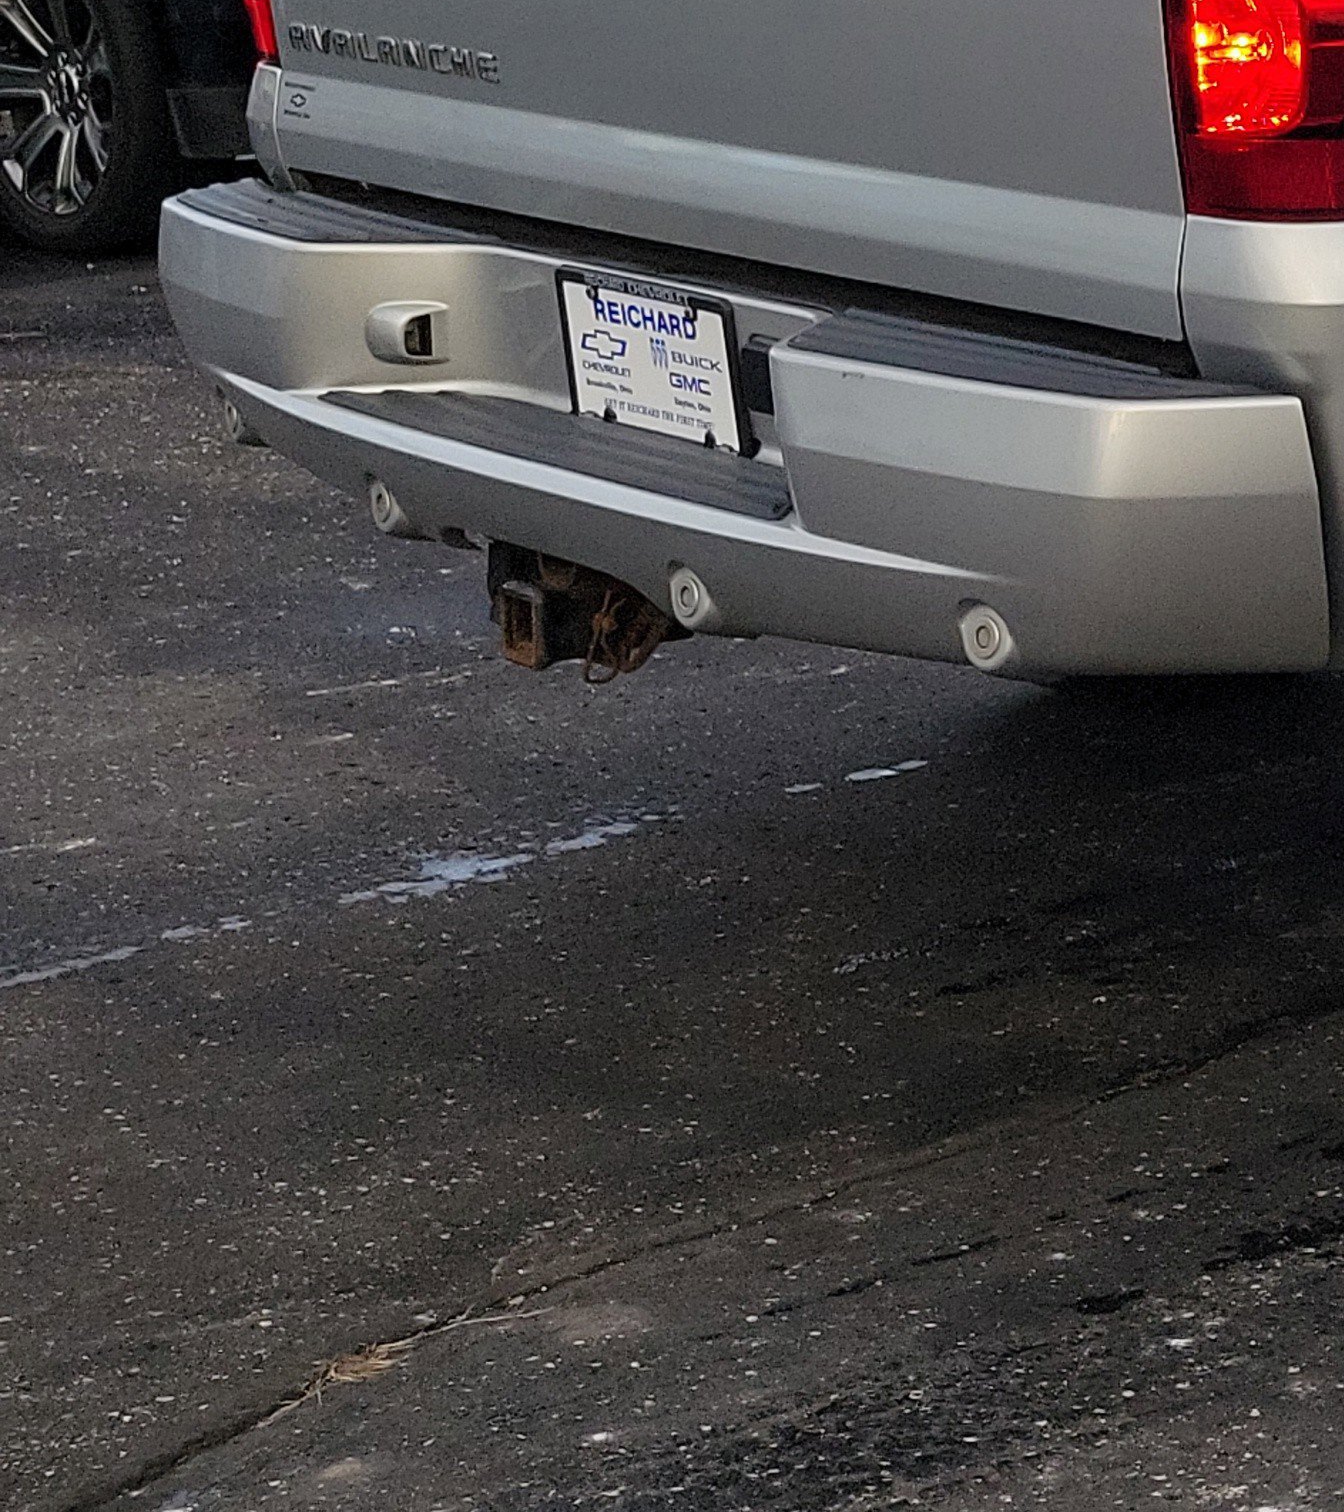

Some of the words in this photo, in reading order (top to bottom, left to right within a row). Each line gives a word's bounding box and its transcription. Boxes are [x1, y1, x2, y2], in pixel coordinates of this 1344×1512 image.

[287, 22, 501, 85] AVALANCHE
[593, 299, 698, 340] REICHARD
[582, 359, 632, 378] CHEVROLET
[670, 349, 723, 374] BUICK
[669, 371, 712, 396] GMC
